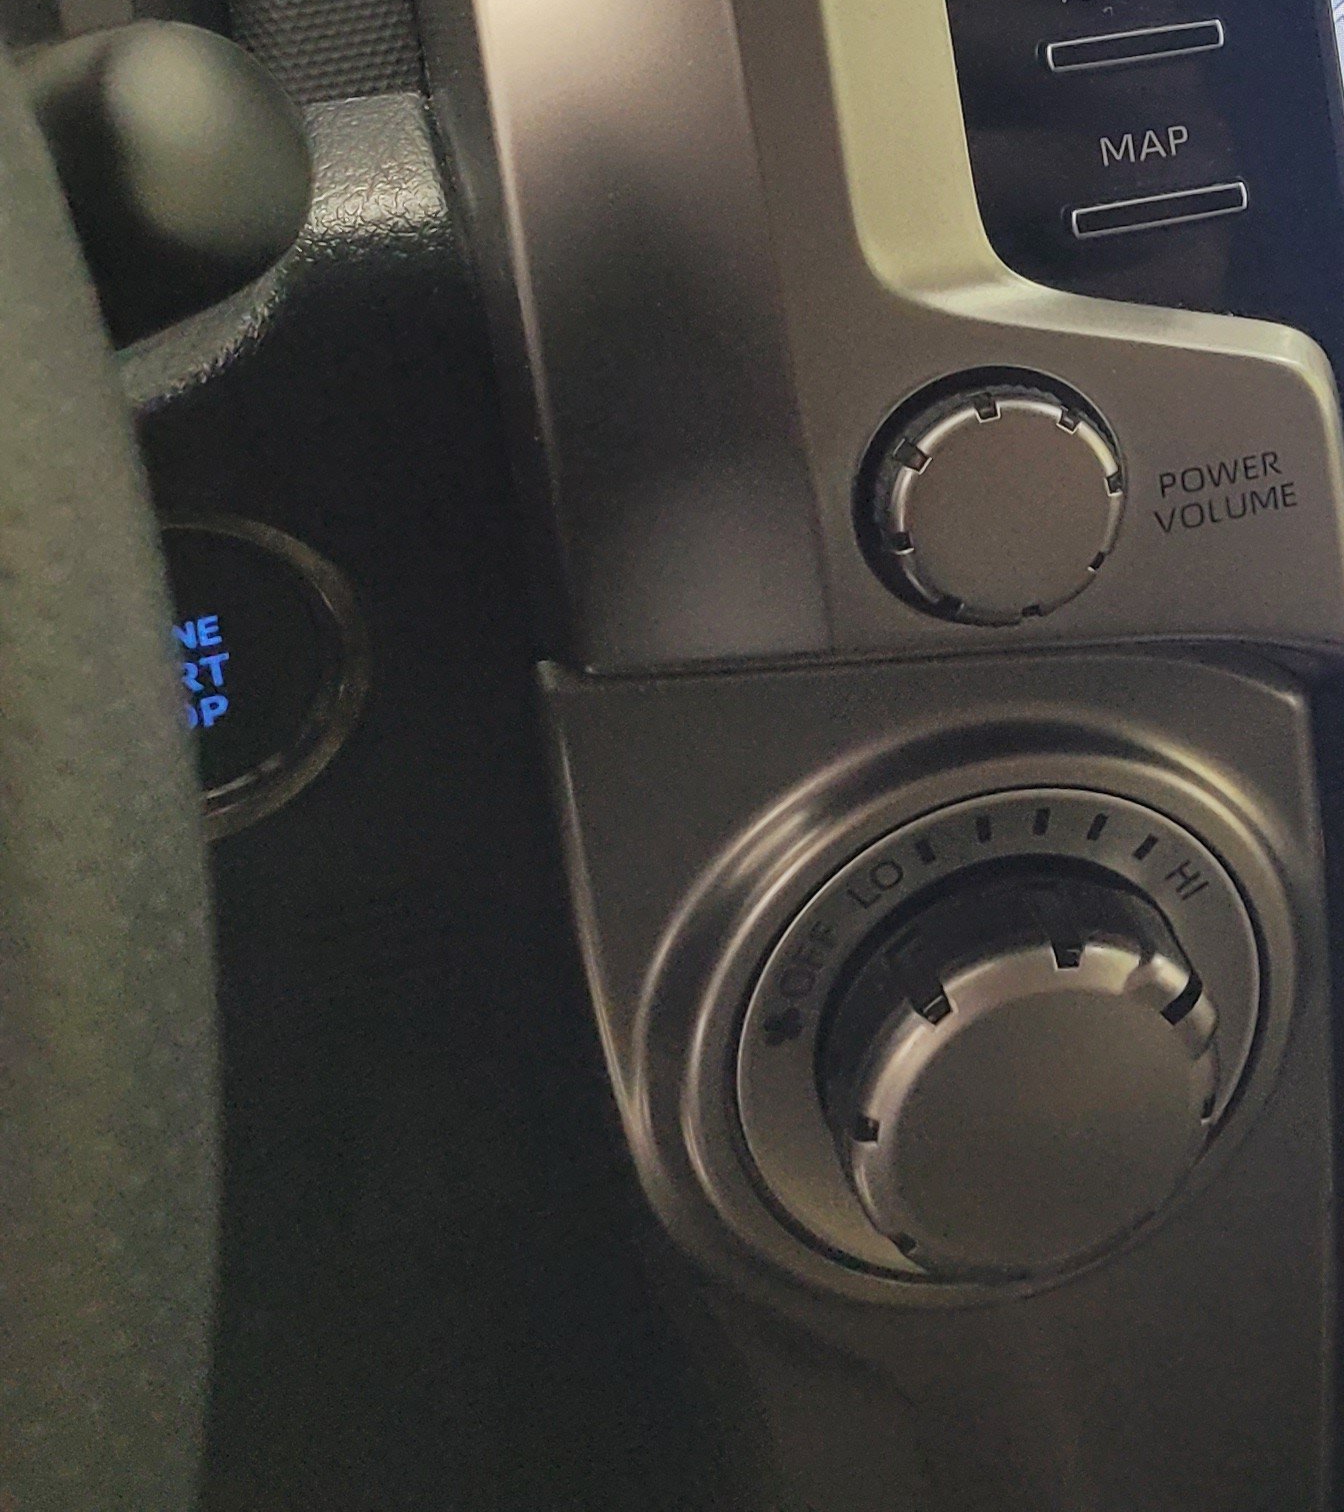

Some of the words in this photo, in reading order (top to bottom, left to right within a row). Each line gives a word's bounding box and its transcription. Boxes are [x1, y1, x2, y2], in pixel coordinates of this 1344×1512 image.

[1099, 124, 1191, 167] MAP
[1158, 450, 1282, 499] POWER
[1153, 482, 1299, 535] VOLUME
[846, 858, 905, 911] LO
[1164, 859, 1210, 903] HI
